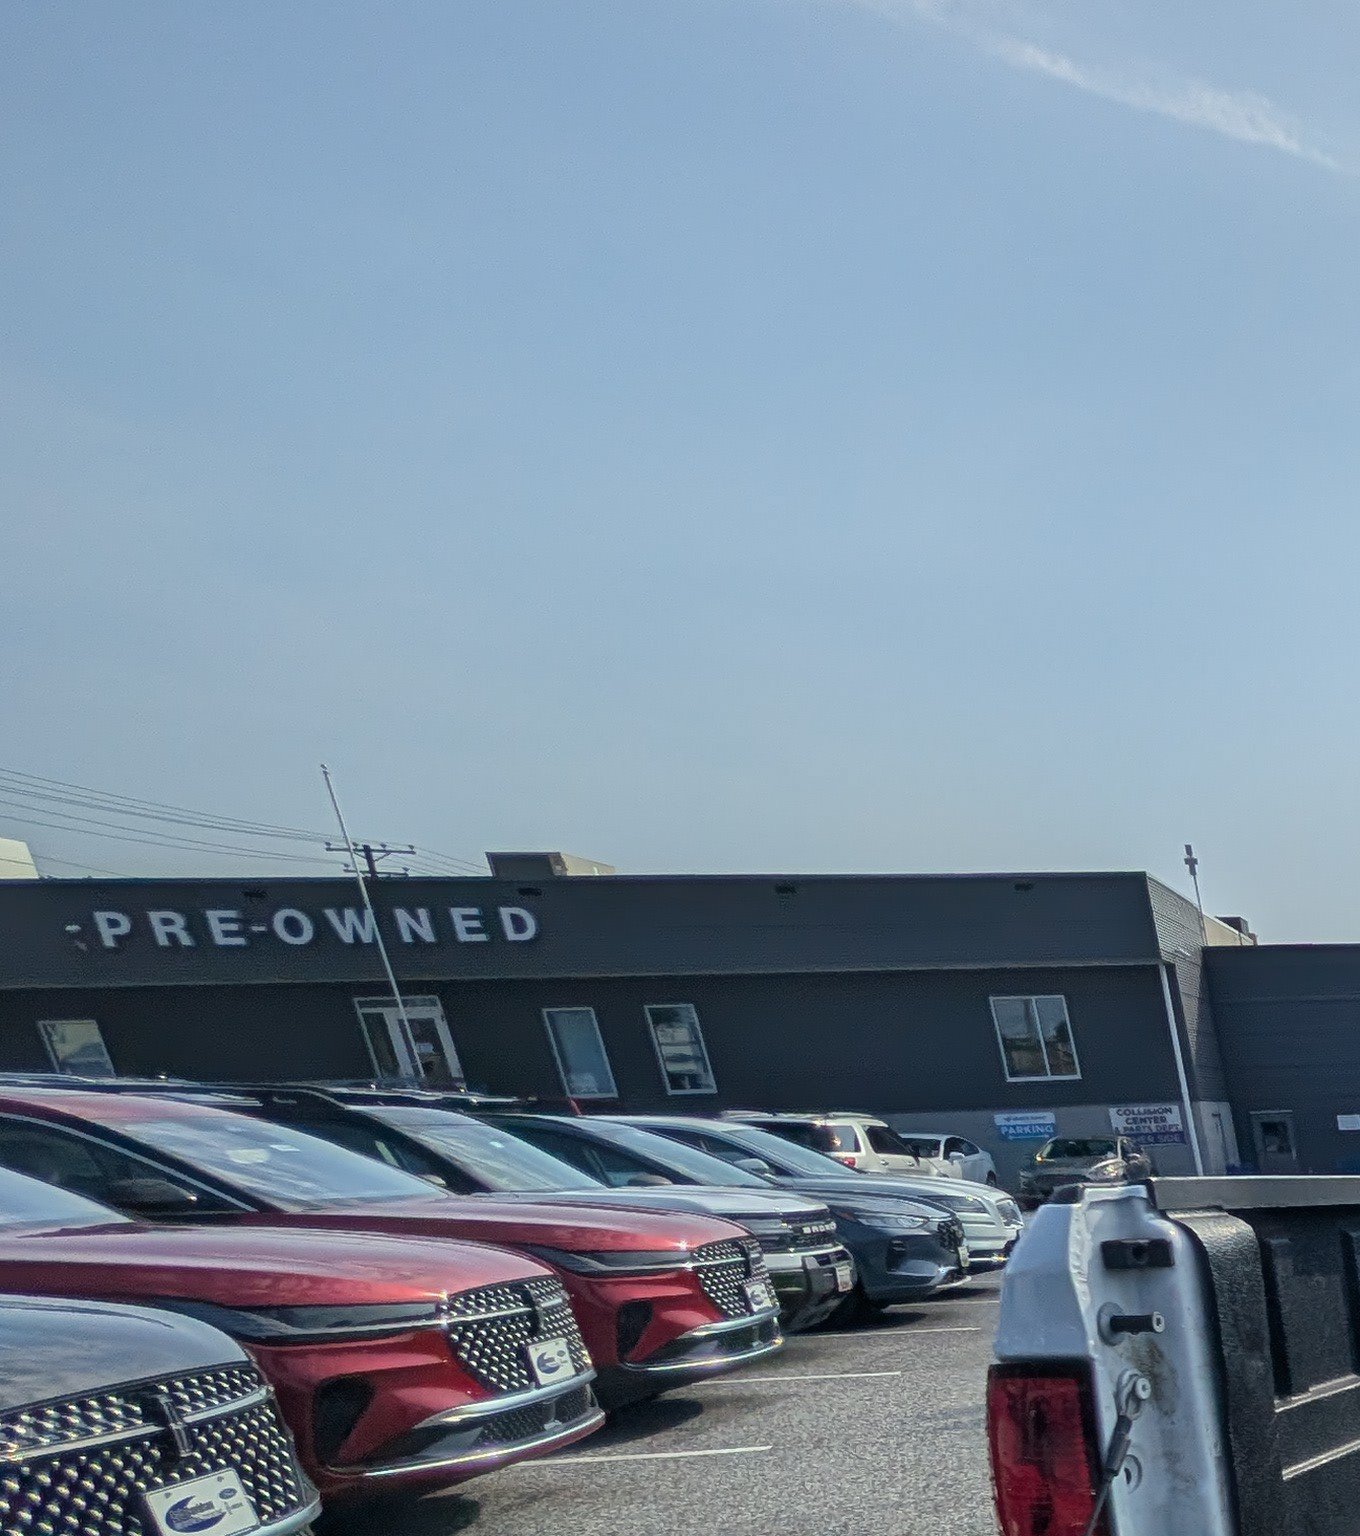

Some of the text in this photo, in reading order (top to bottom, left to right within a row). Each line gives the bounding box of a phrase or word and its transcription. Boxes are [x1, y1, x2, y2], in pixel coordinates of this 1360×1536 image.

[93, 906, 539, 948] PRE-OWNED
[1116, 1106, 1173, 1117] COLLISION
[1125, 1116, 1168, 1125] CENTER
[1000, 1125, 1054, 1136] PARKING
